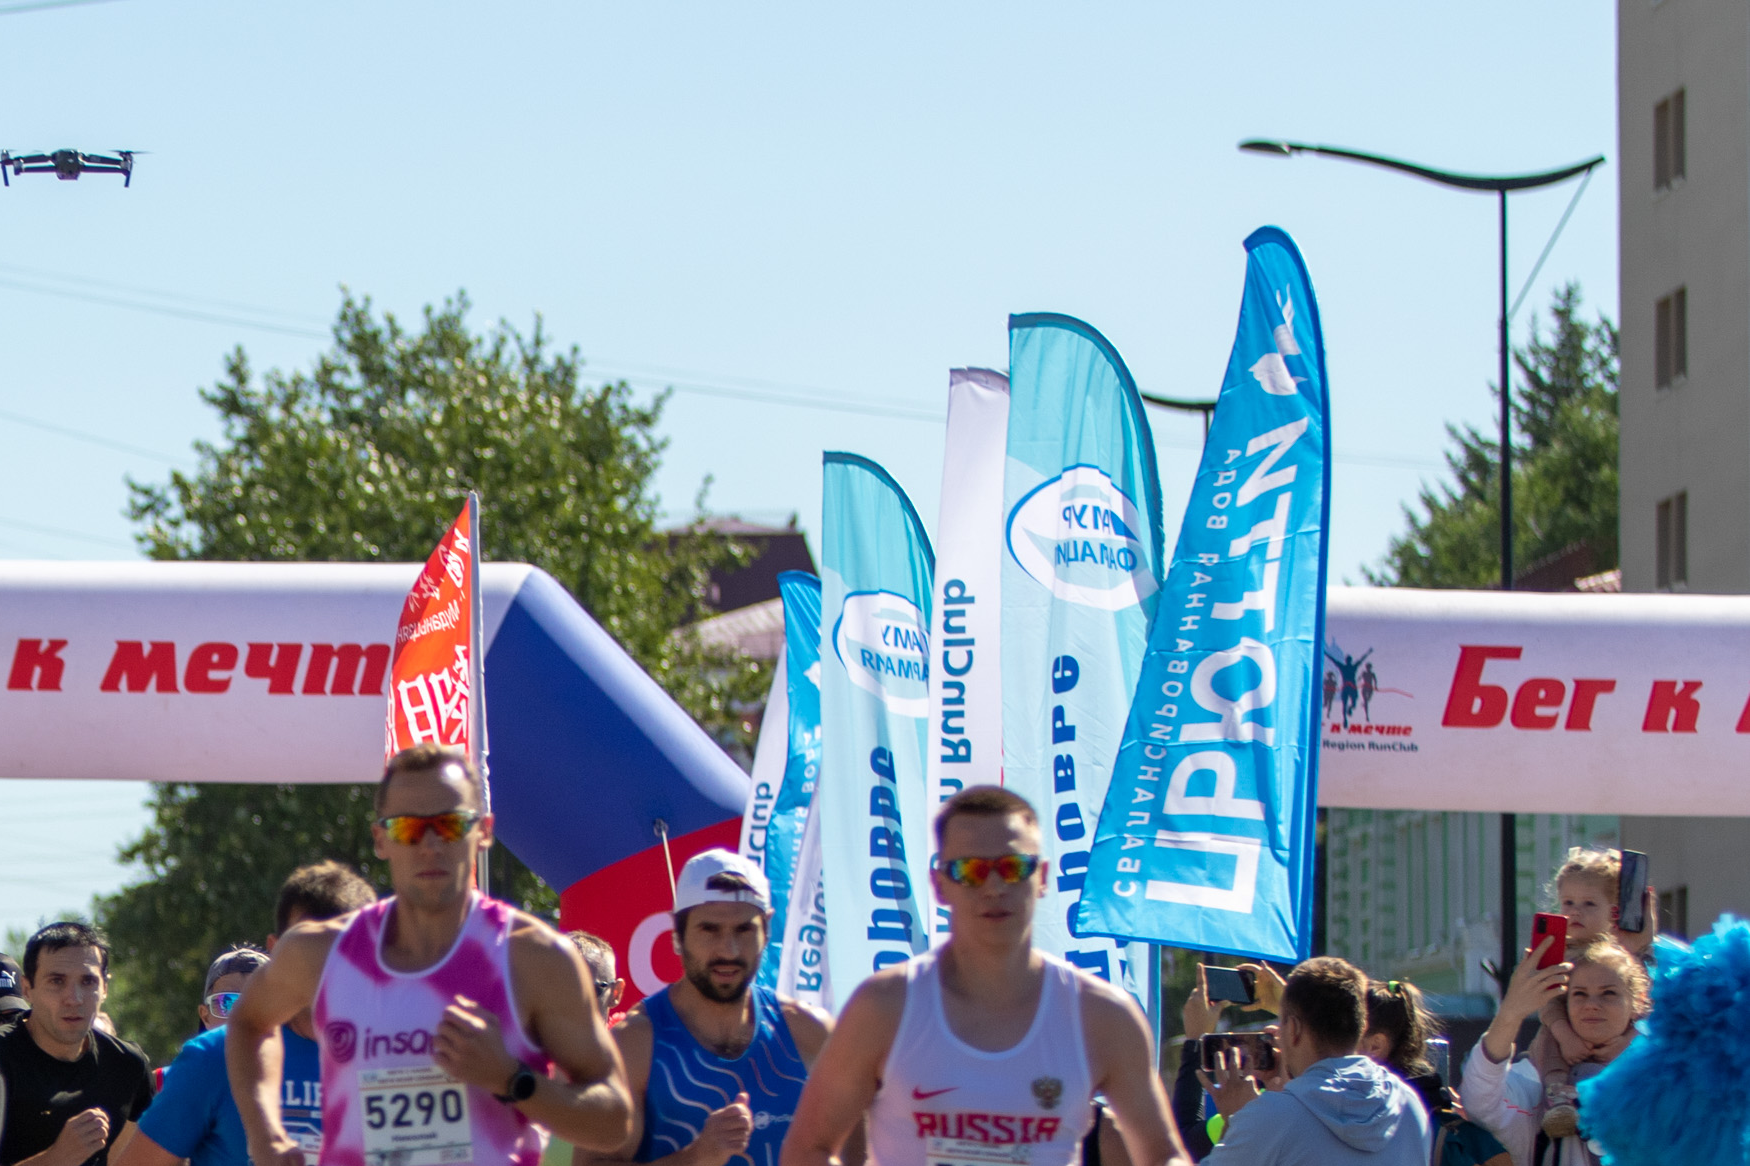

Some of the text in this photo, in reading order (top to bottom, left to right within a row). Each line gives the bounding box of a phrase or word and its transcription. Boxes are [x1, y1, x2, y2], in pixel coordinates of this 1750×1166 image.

[99, 639, 391, 697] мечт
[1440, 644, 1617, 732] Бег
[1322, 740, 1419, 752] Region RunClub
[365, 1089, 463, 1130] 5290
[913, 1112, 1061, 1145] RUSSIA
